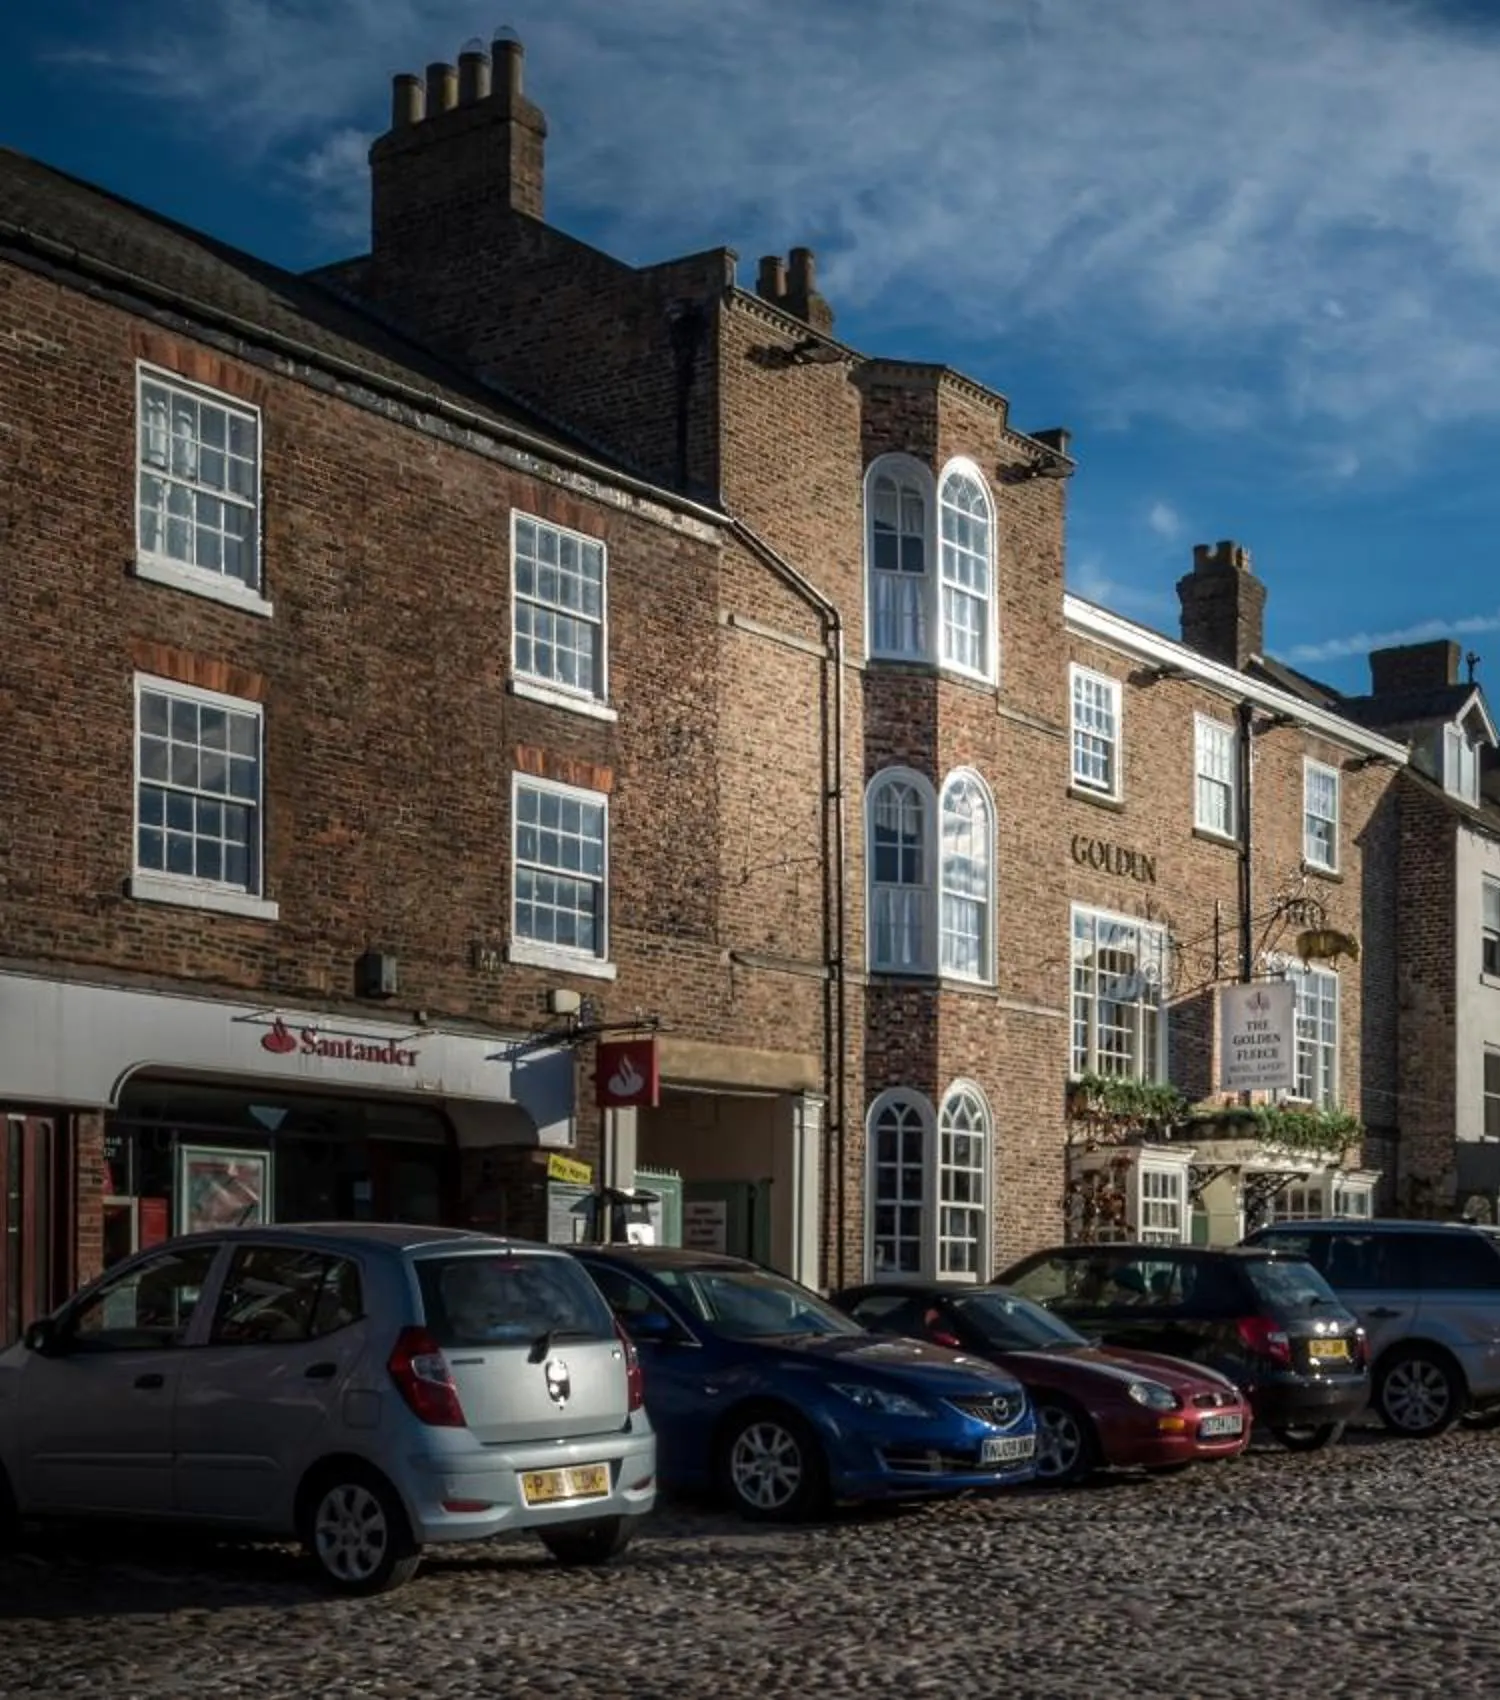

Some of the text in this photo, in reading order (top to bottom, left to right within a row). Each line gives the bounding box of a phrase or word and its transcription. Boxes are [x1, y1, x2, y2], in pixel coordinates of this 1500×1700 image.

[1071, 834, 1157, 884] GOLDEN
[1247, 1020, 1268, 1032] THE
[1232, 1032, 1281, 1046] GOLDEN
[301, 1027, 421, 1067] Santander
[1236, 1047, 1279, 1061] FLEECE
